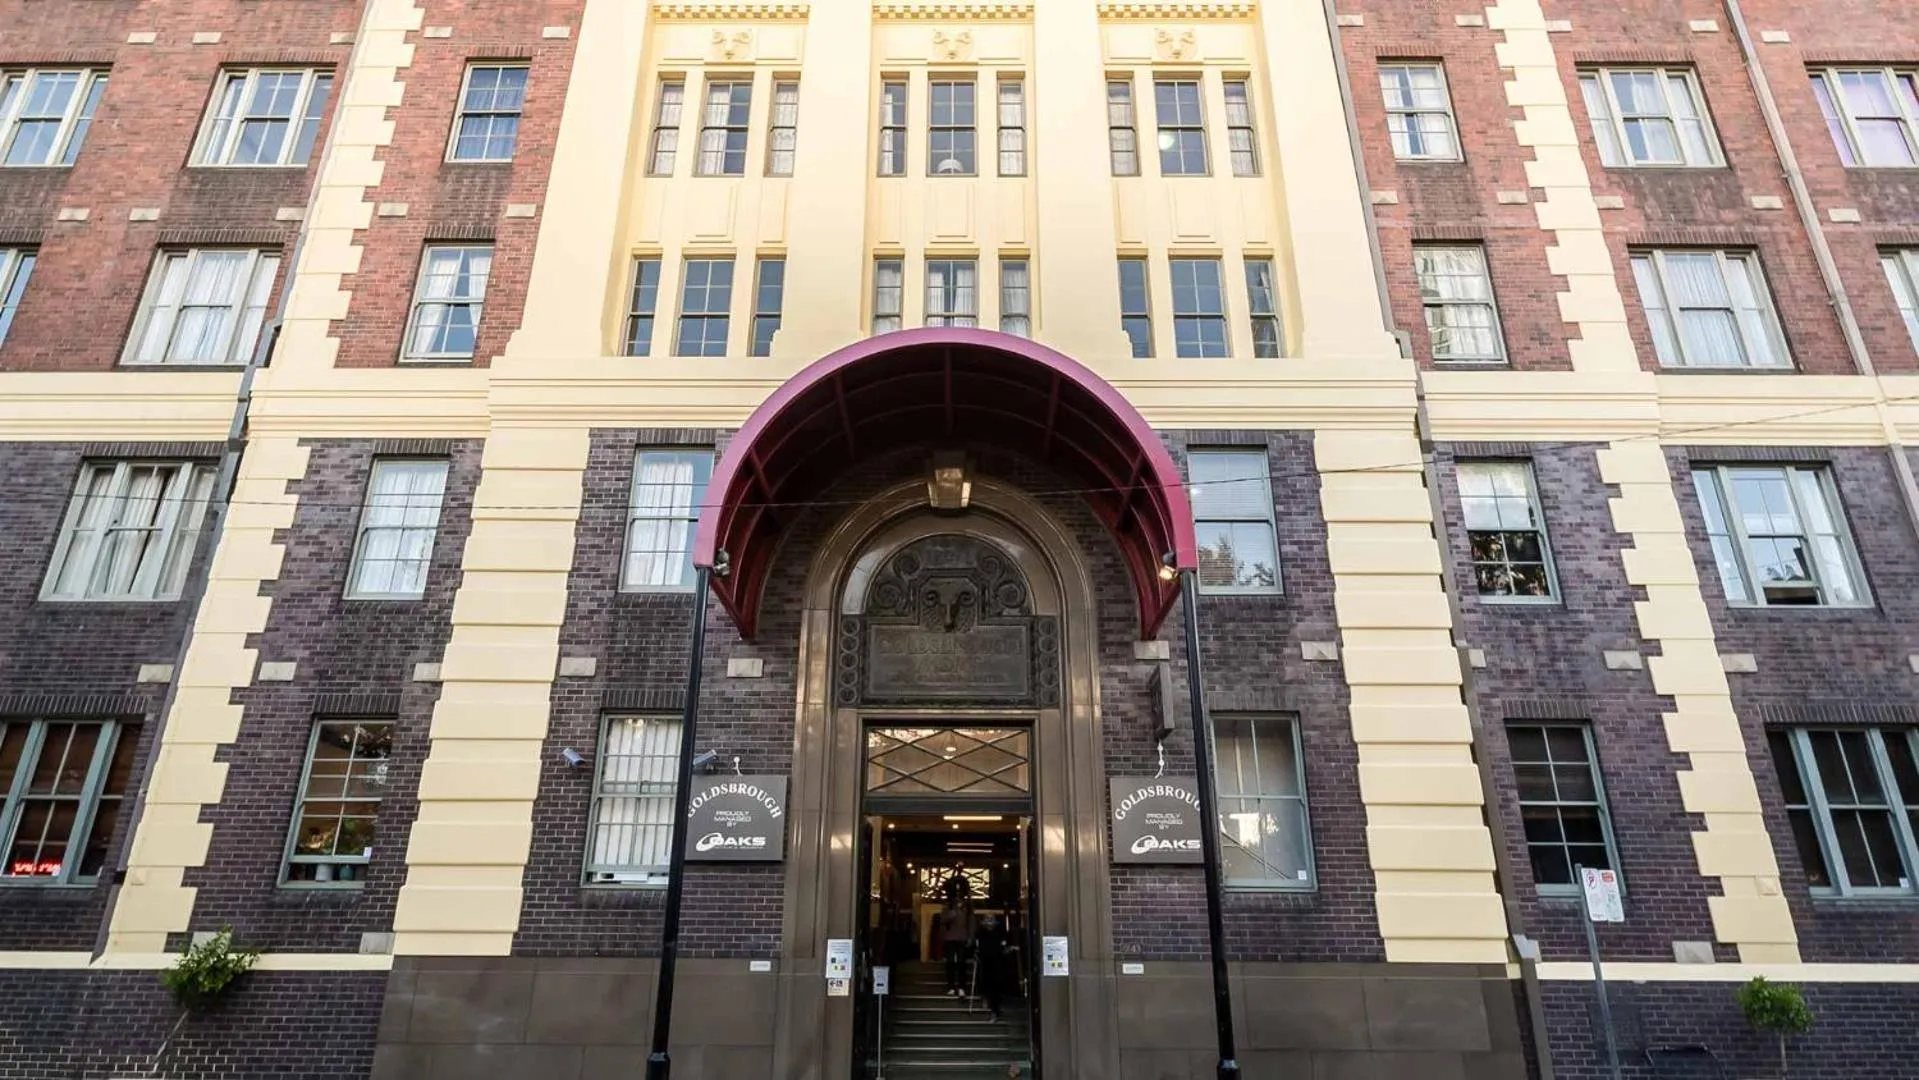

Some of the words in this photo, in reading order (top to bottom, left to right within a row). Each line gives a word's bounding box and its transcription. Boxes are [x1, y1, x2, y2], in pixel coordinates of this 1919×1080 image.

[688, 783, 782, 819] GOLDSBROUGH
[699, 834, 766, 849] OAKS
[1134, 837, 1201, 852] OAKS
